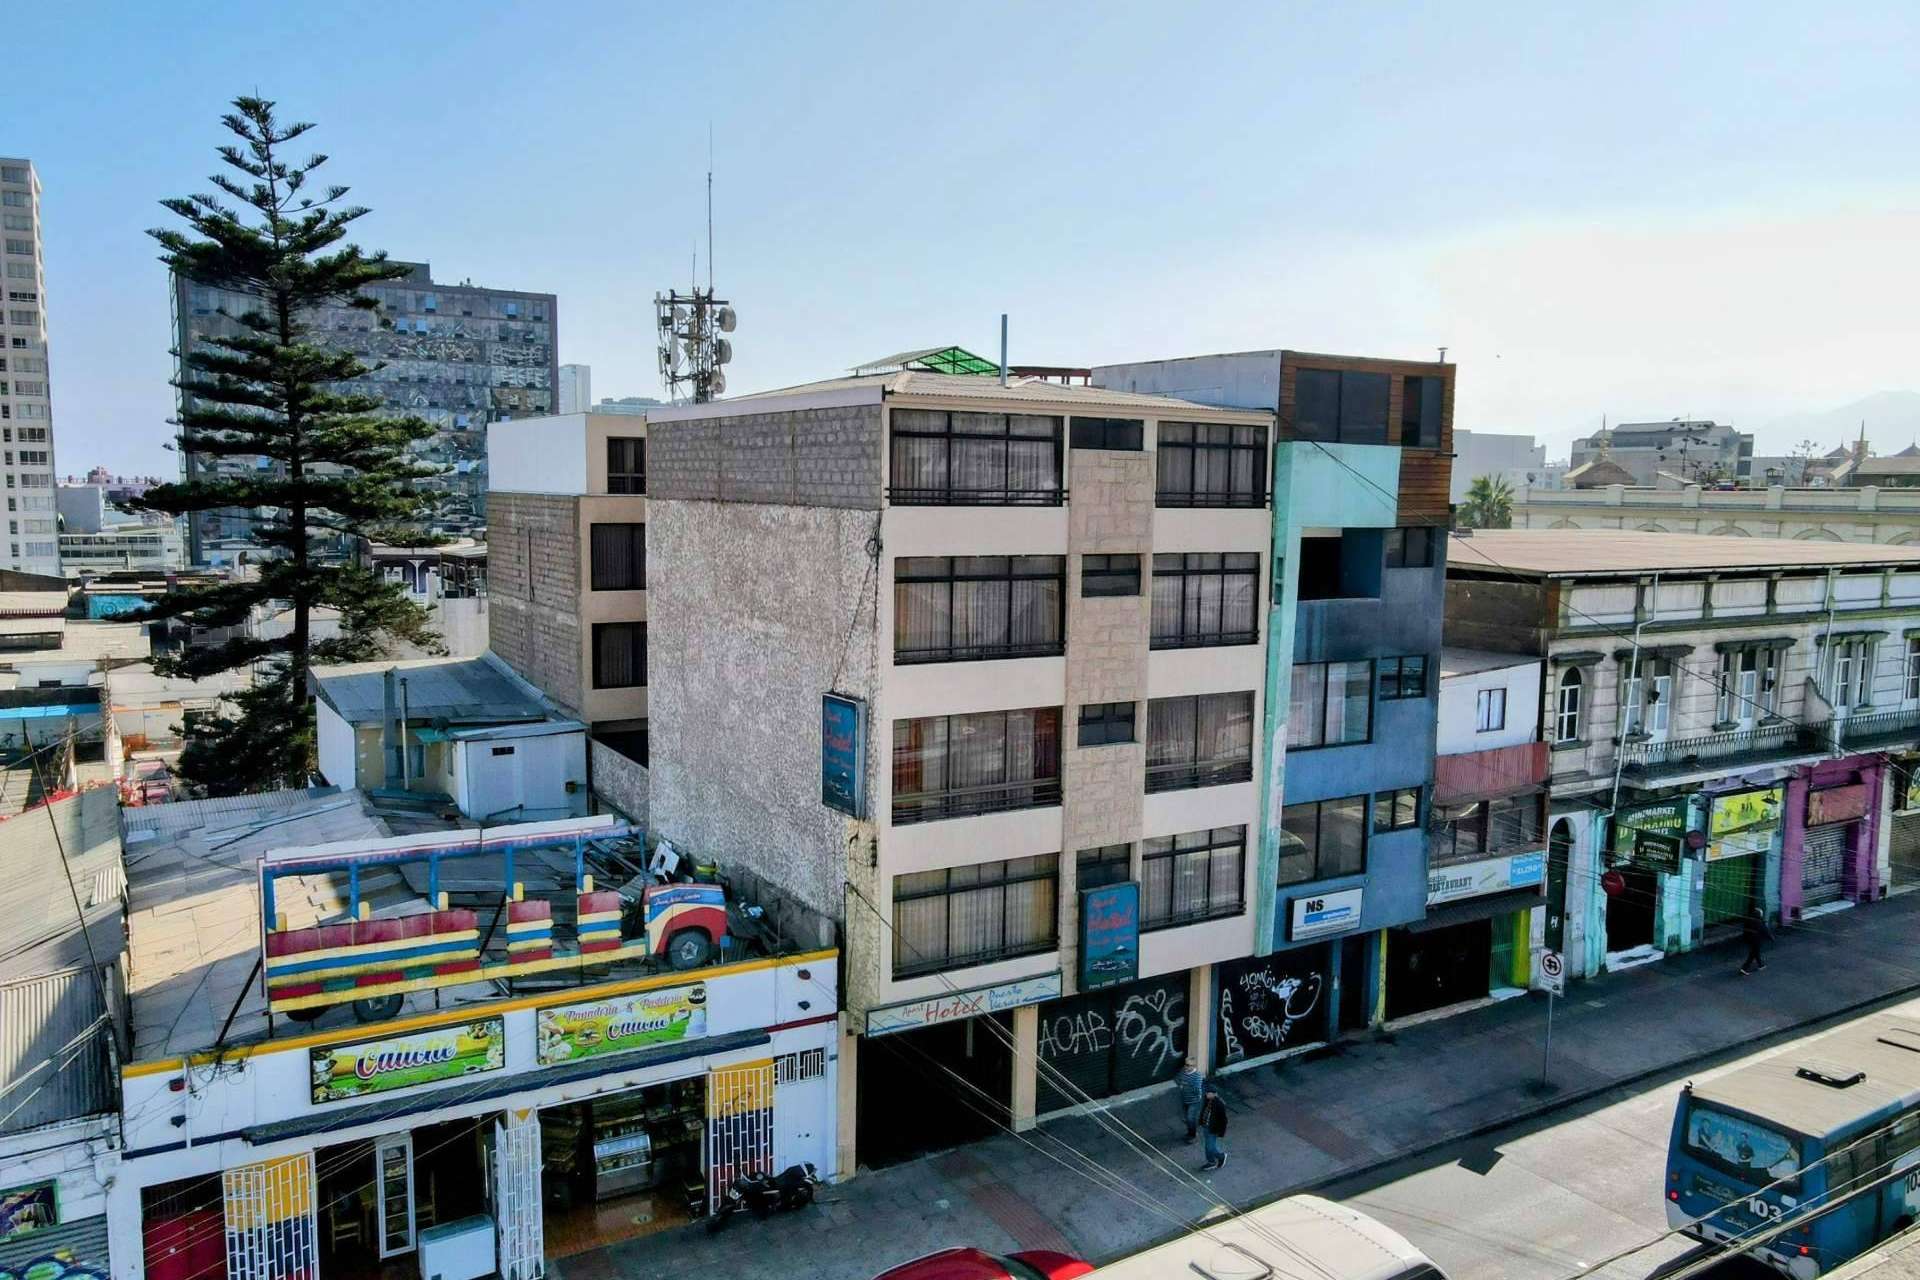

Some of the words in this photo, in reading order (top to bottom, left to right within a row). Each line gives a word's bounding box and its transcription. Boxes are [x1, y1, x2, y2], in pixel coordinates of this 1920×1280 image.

[1306, 900, 1324, 913] NS
[925, 995, 983, 1023] Hotel
[1746, 1196, 1782, 1223] 103
